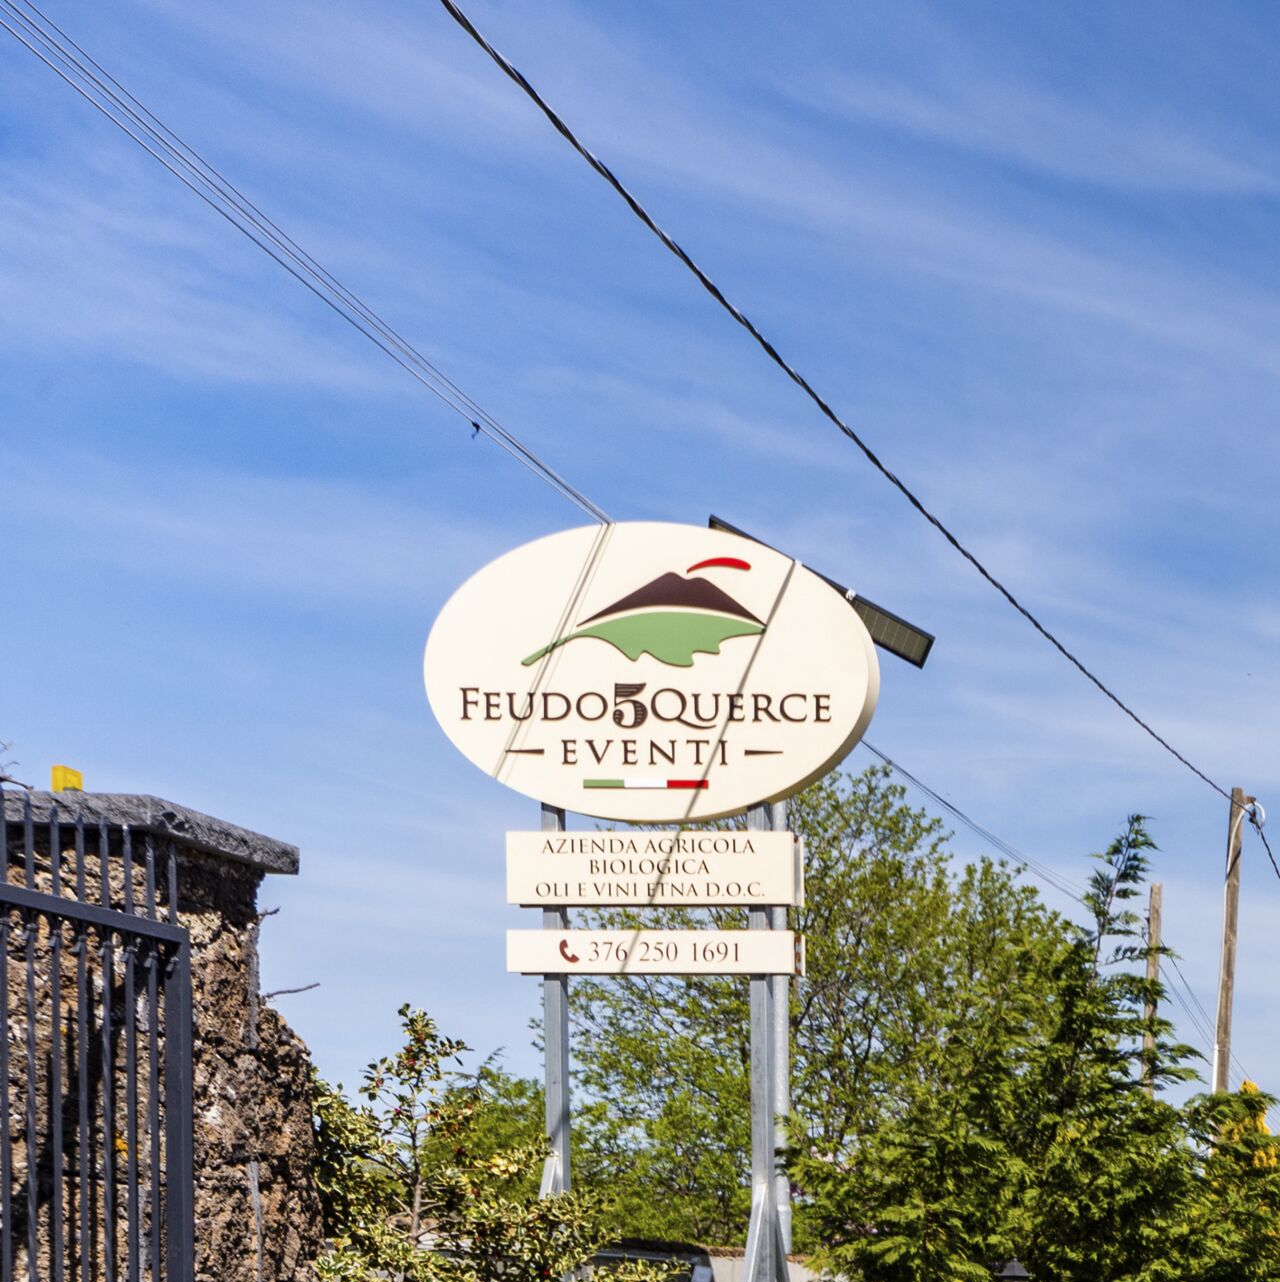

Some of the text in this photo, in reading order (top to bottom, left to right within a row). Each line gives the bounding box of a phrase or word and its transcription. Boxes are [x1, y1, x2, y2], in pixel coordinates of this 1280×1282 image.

[561, 739, 729, 766] EVENTI
[542, 838, 756, 854] AZIENDA AGRICOLA
[589, 859, 710, 875] BIOLOGICA
[535, 882, 765, 898] OLI E VINI ETNA D.O.C.
[588, 941, 741, 962] 376 250 1691
